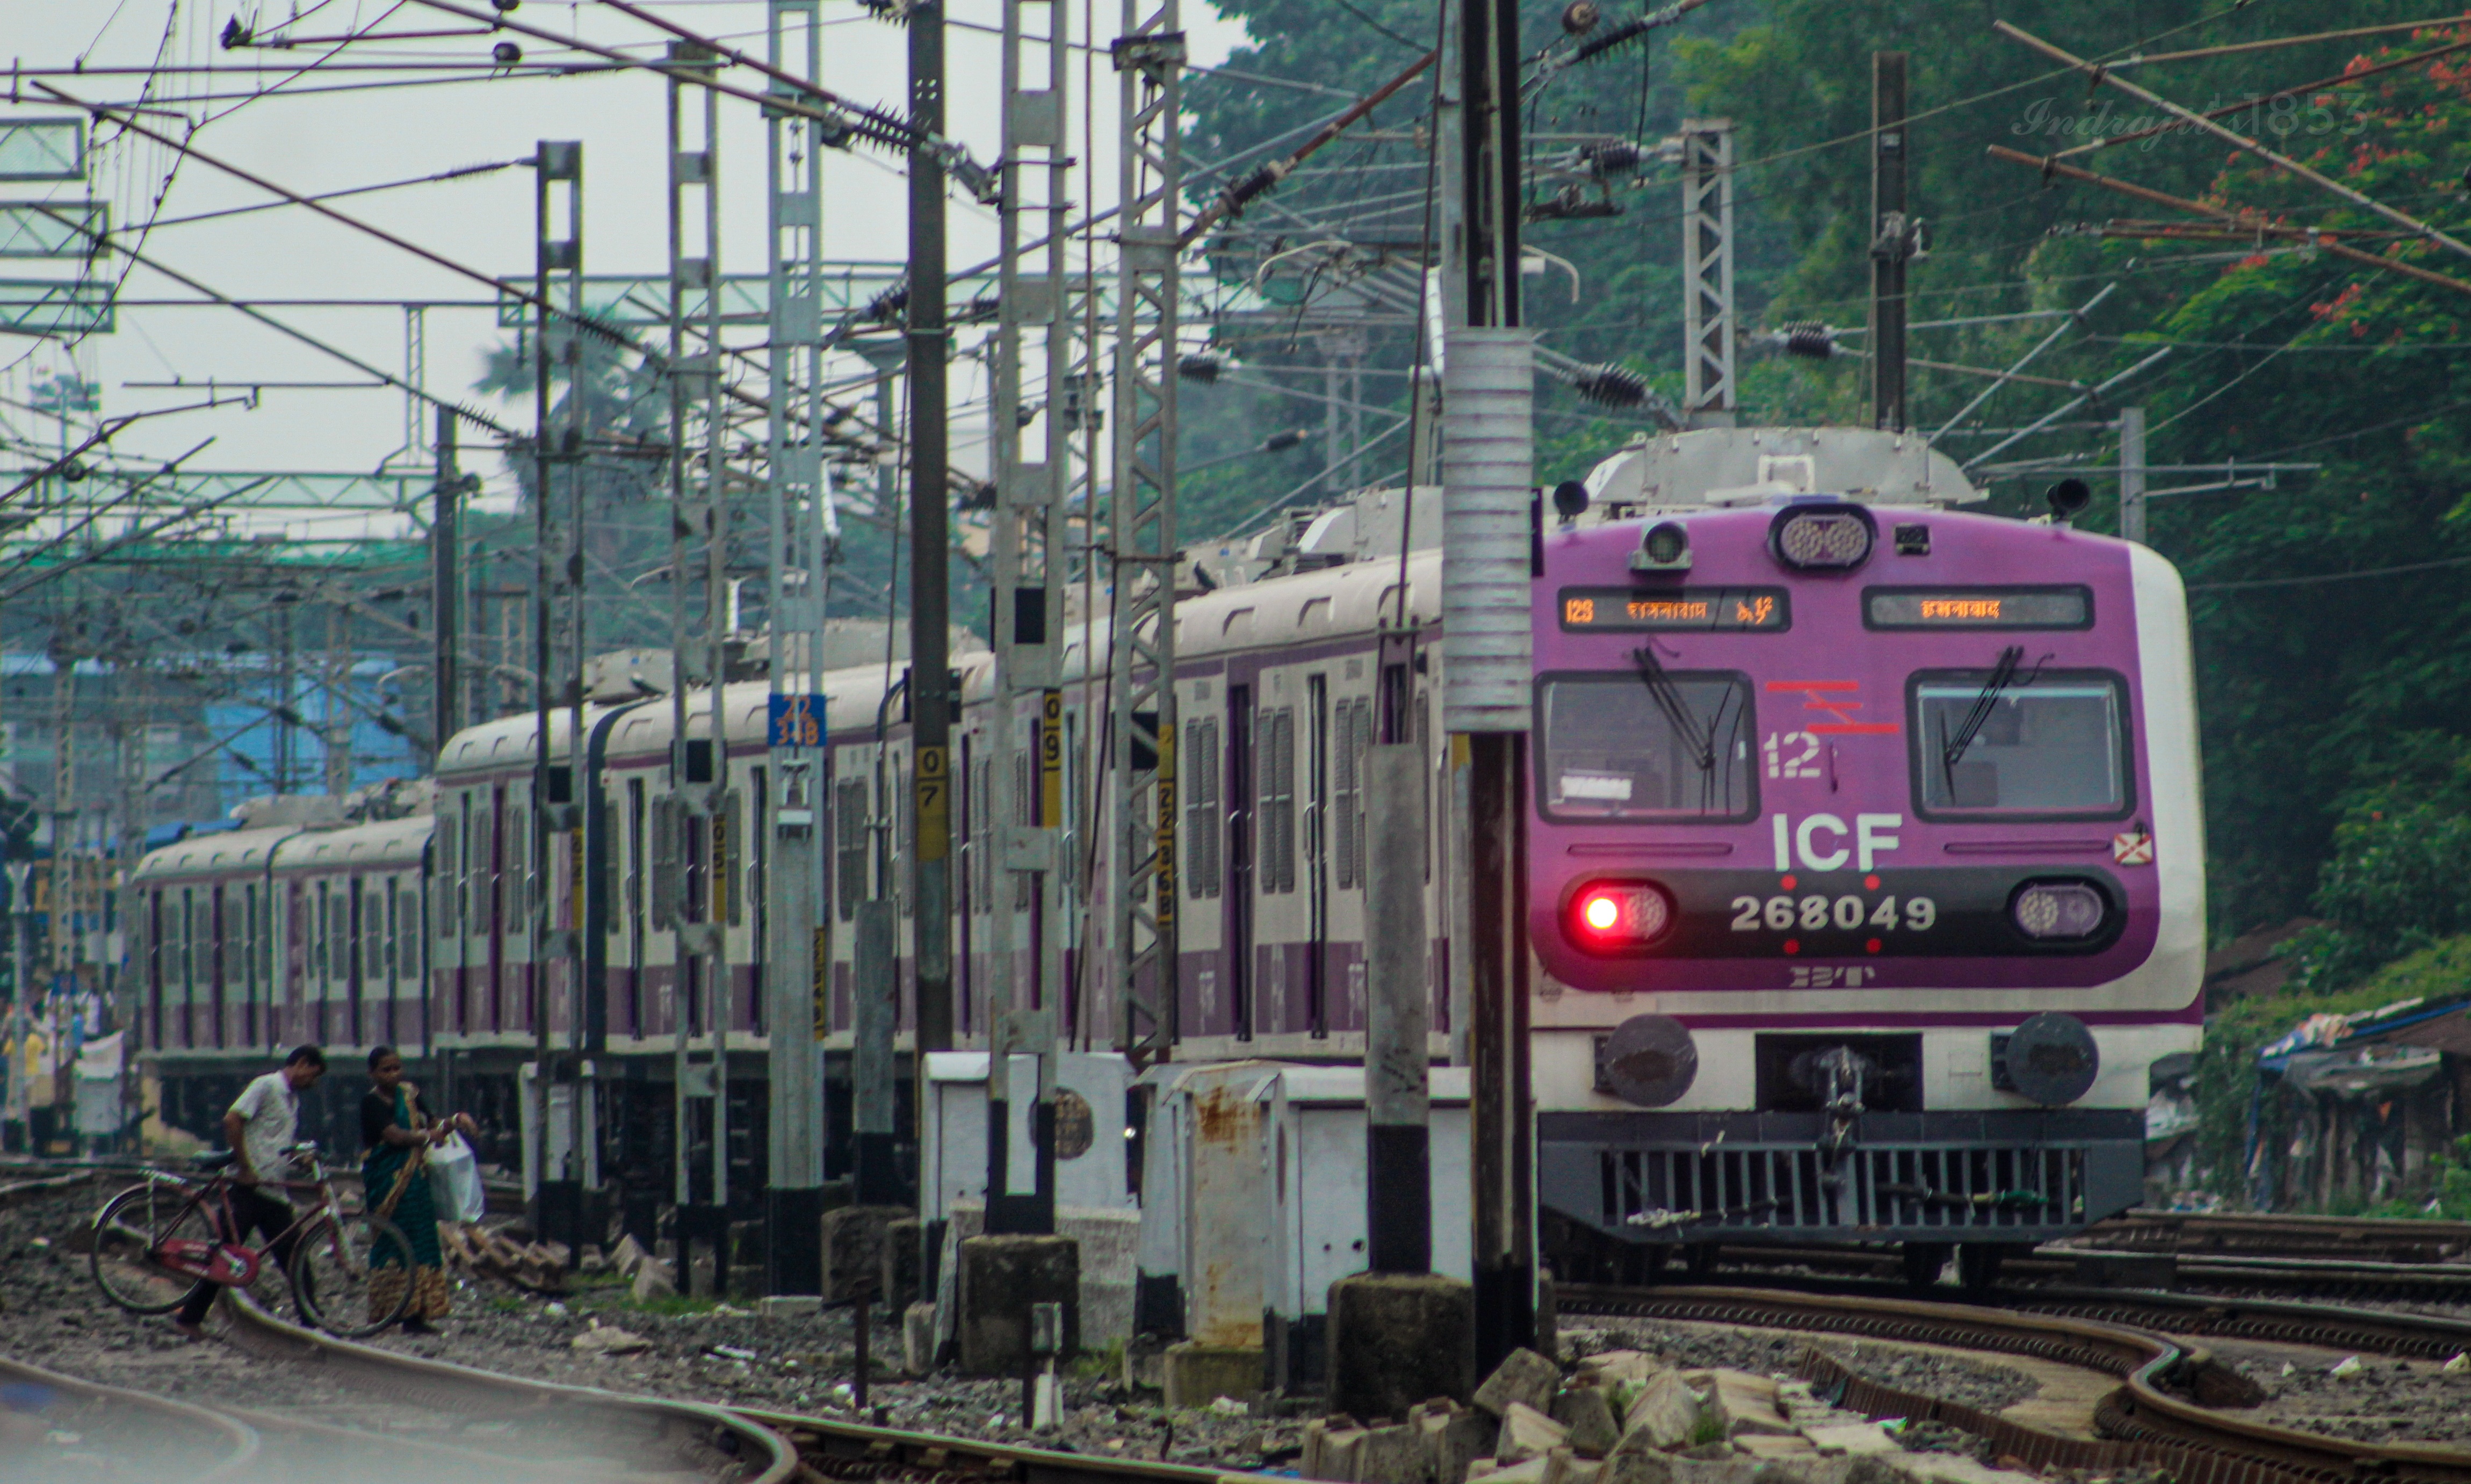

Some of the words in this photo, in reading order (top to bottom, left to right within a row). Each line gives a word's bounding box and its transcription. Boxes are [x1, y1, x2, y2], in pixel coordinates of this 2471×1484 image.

[1764, 731, 1821, 778] 12
[1773, 813, 1903, 872] ICF
[1731, 894, 1937, 932] 268049
